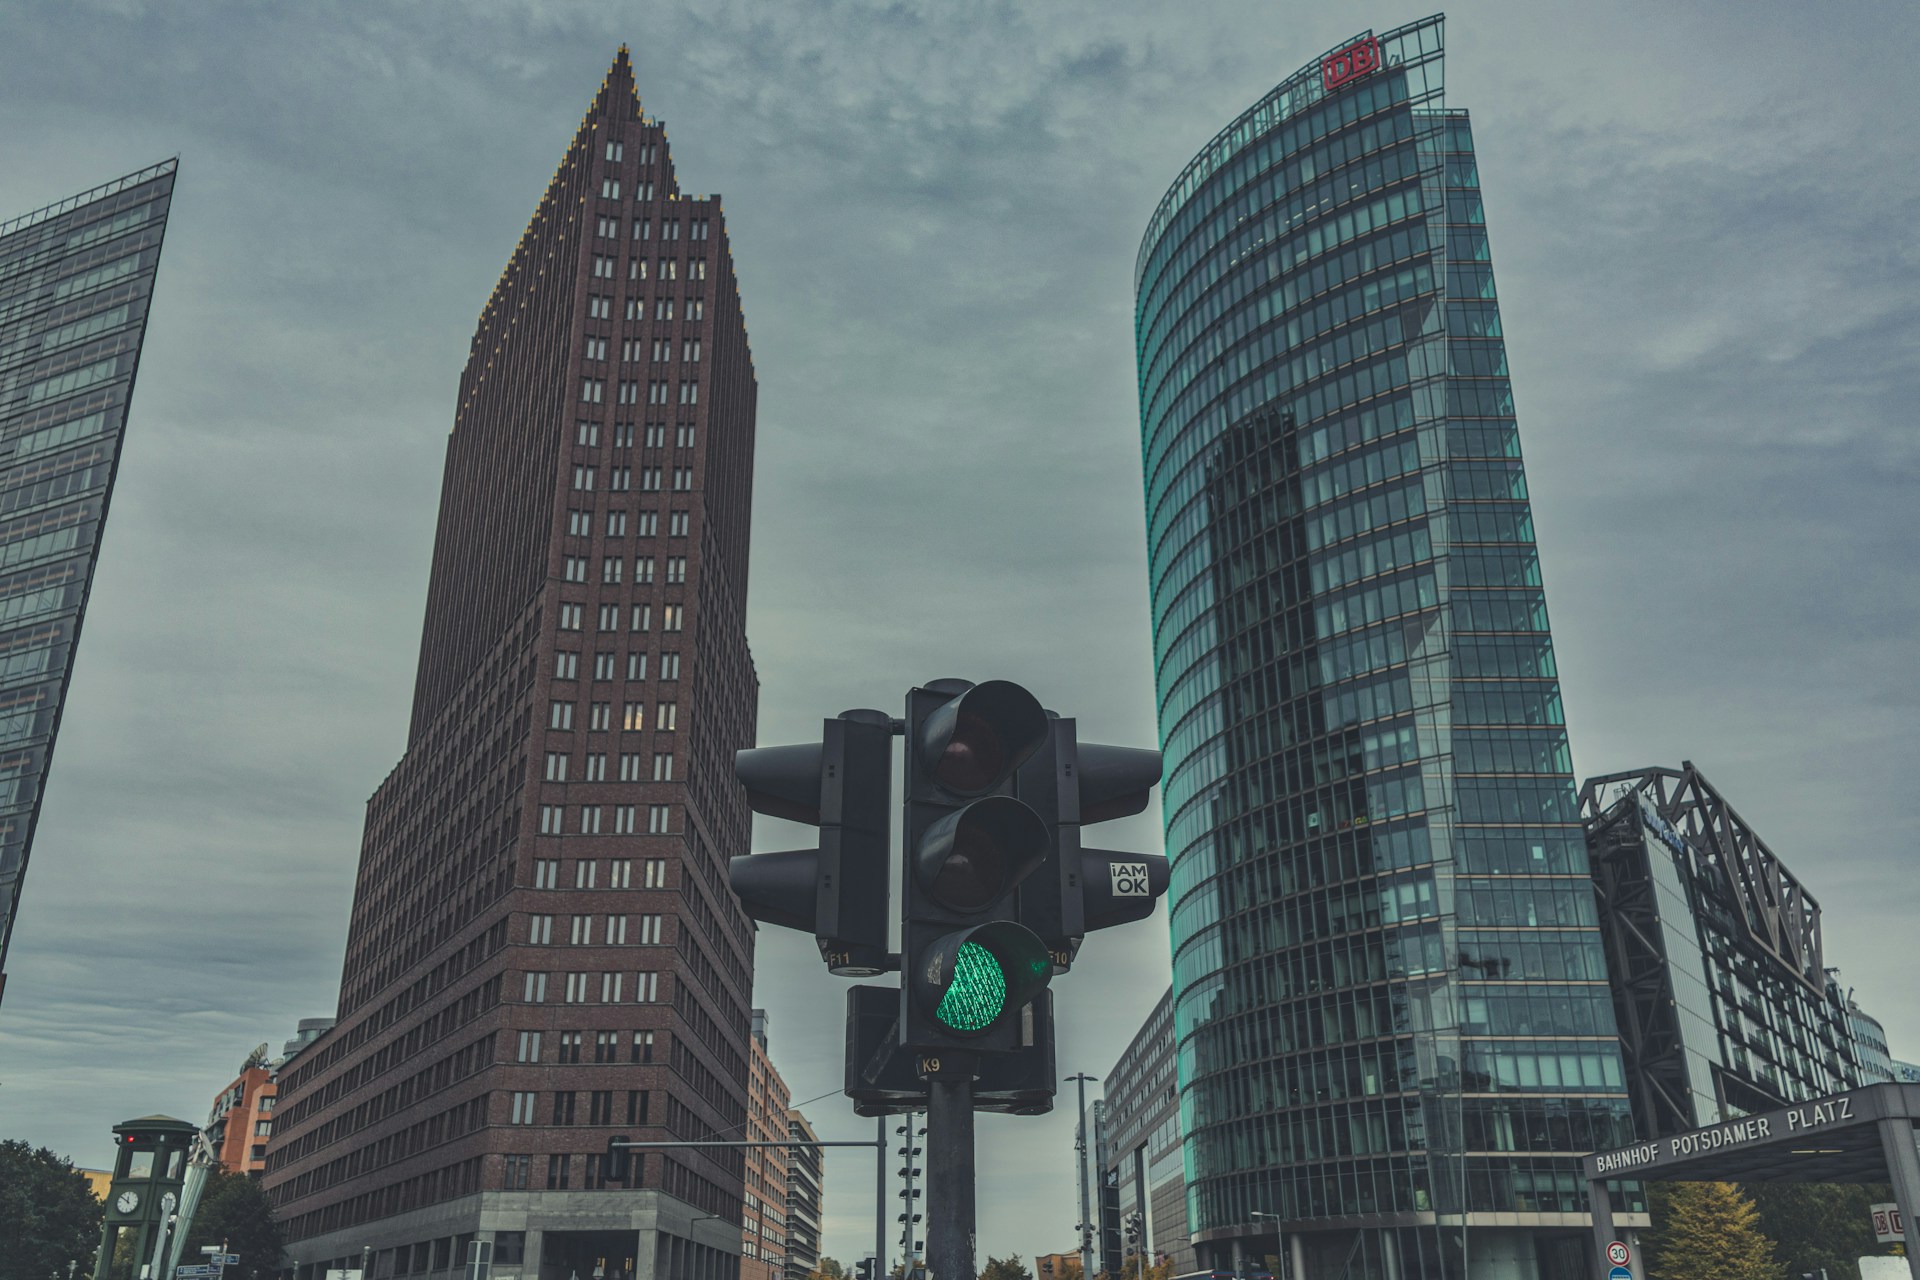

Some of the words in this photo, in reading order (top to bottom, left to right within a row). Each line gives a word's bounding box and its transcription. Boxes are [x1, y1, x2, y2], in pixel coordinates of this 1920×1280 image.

[1330, 45, 1373, 84] DB
[1117, 878, 1148, 894] OK
[830, 951, 850, 967] F11
[922, 1057, 941, 1073] K9
[1596, 1143, 1660, 1173] BAHNHOF
[1671, 1117, 1771, 1157] POTSDAMER
[1786, 1097, 1854, 1131] PLATZ
[1611, 1248, 1626, 1260] 30
